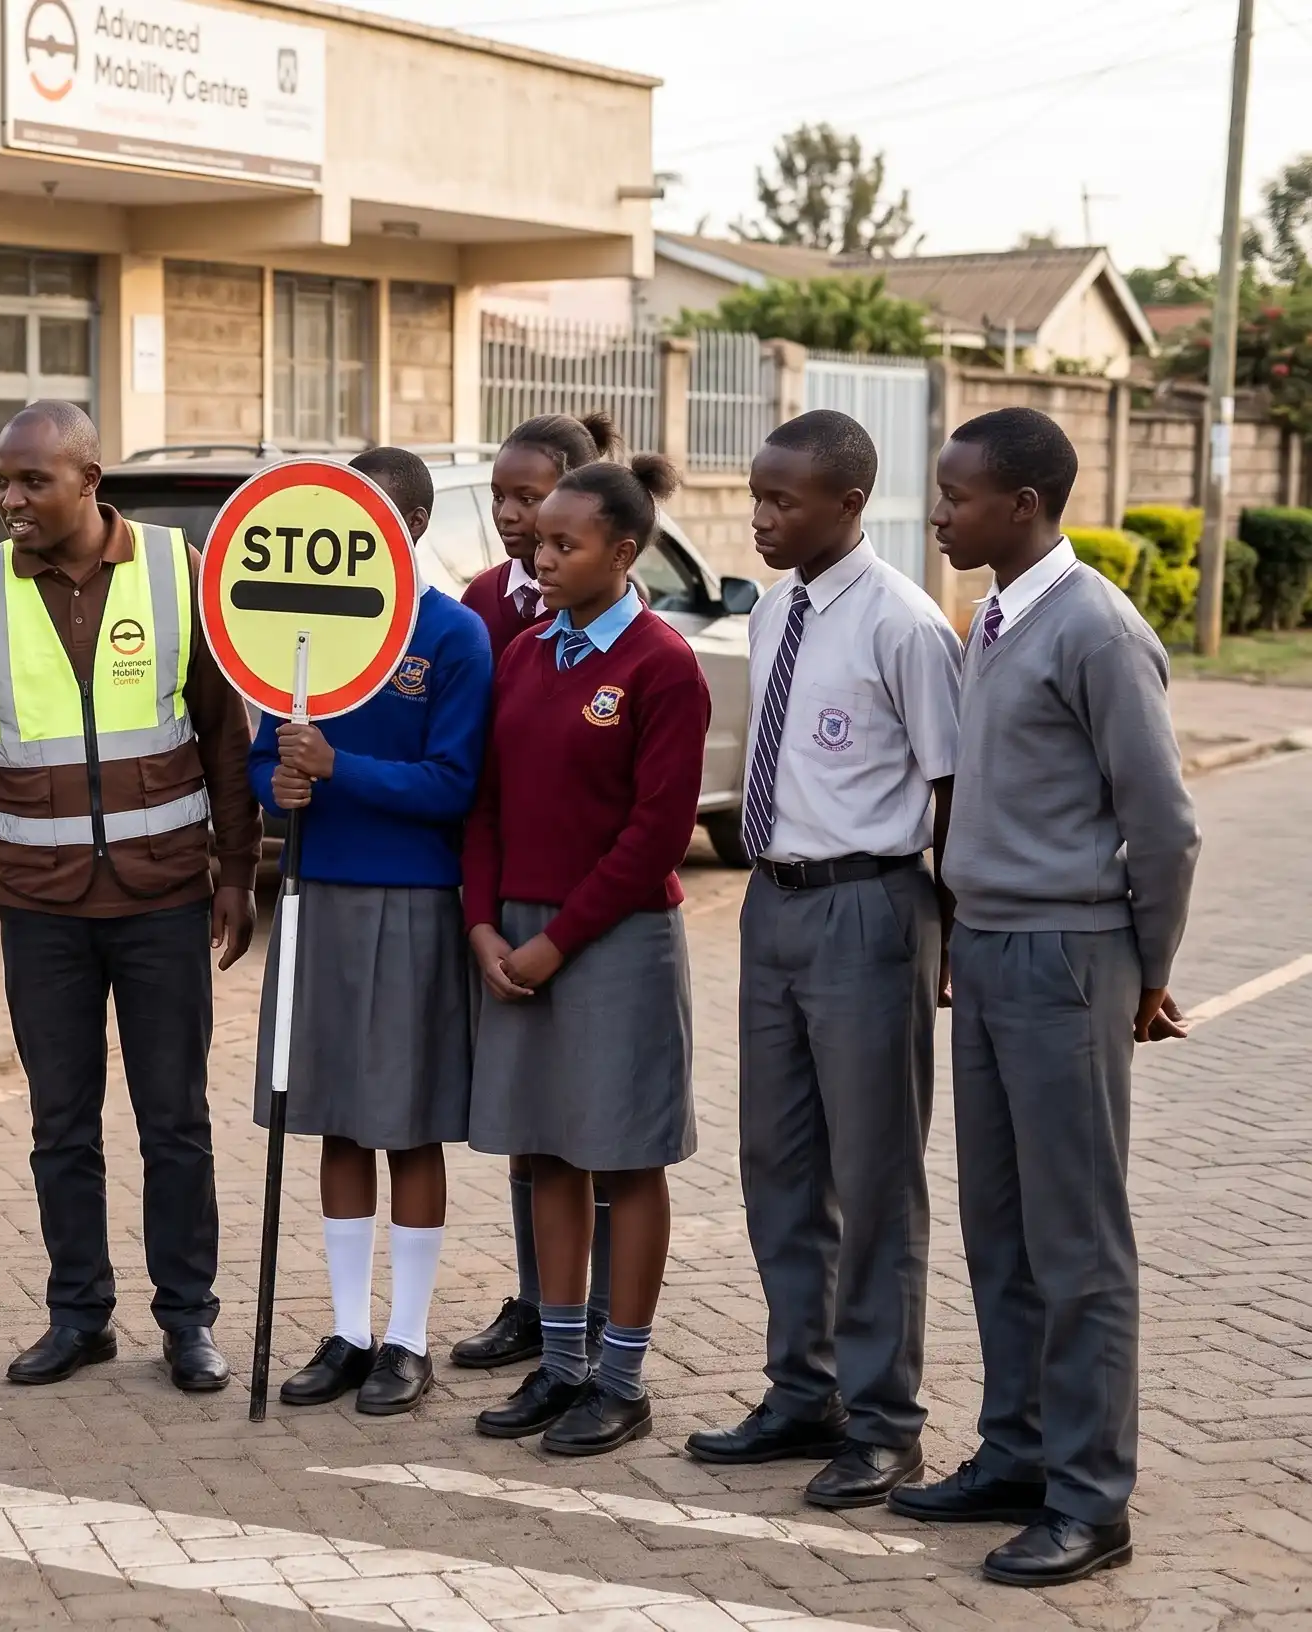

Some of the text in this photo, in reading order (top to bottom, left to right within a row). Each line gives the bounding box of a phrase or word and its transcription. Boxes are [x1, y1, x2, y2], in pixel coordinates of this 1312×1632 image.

[95, 6, 200, 54] Advanced
[94, 53, 249, 108] Mobility Centre
[241, 525, 376, 577] STOP
